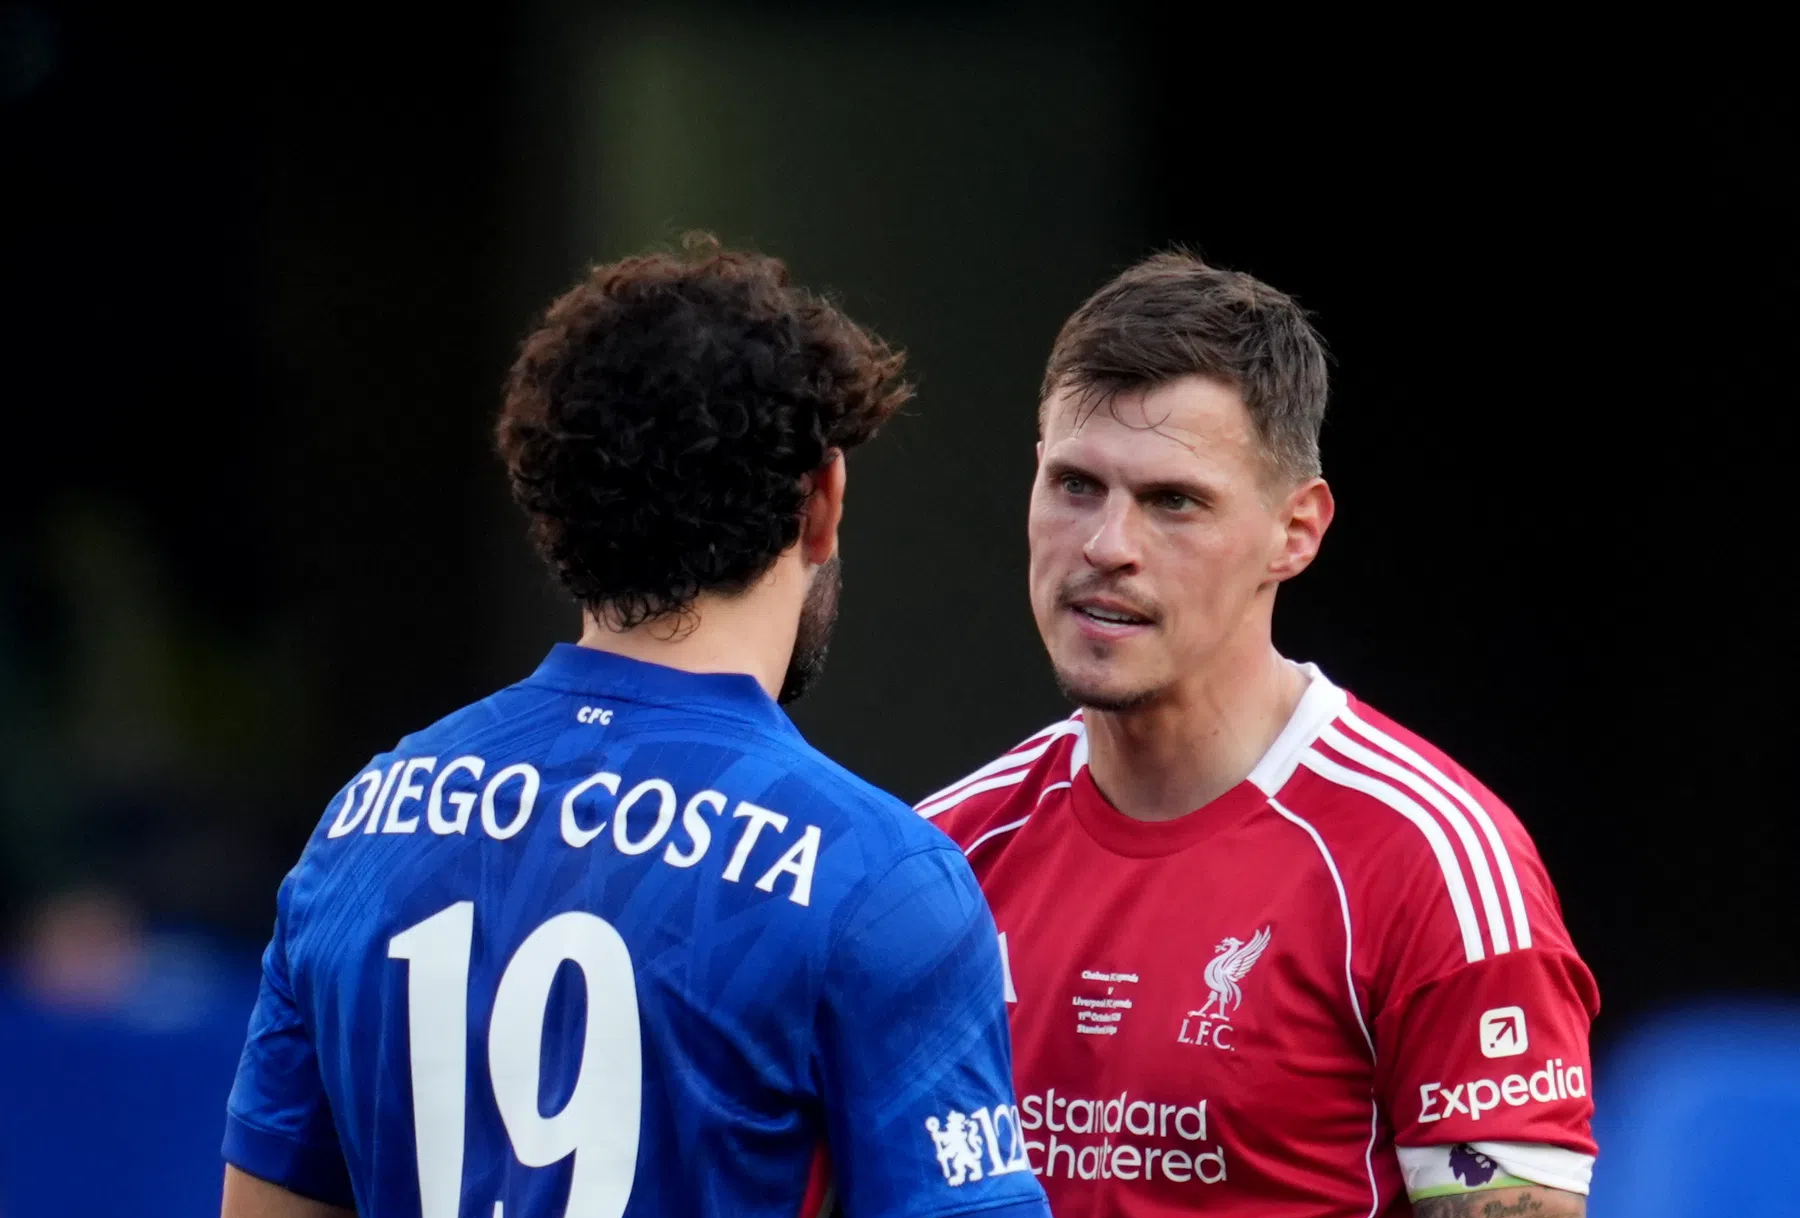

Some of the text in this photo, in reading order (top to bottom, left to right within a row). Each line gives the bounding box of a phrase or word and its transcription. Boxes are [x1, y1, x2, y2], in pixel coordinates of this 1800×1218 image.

[328, 755, 822, 907] DIEGO COSTA
[1021, 1088, 1207, 1141] standard
[1418, 1058, 1587, 1124] Expedia
[1024, 1134, 1228, 1185] chatered
